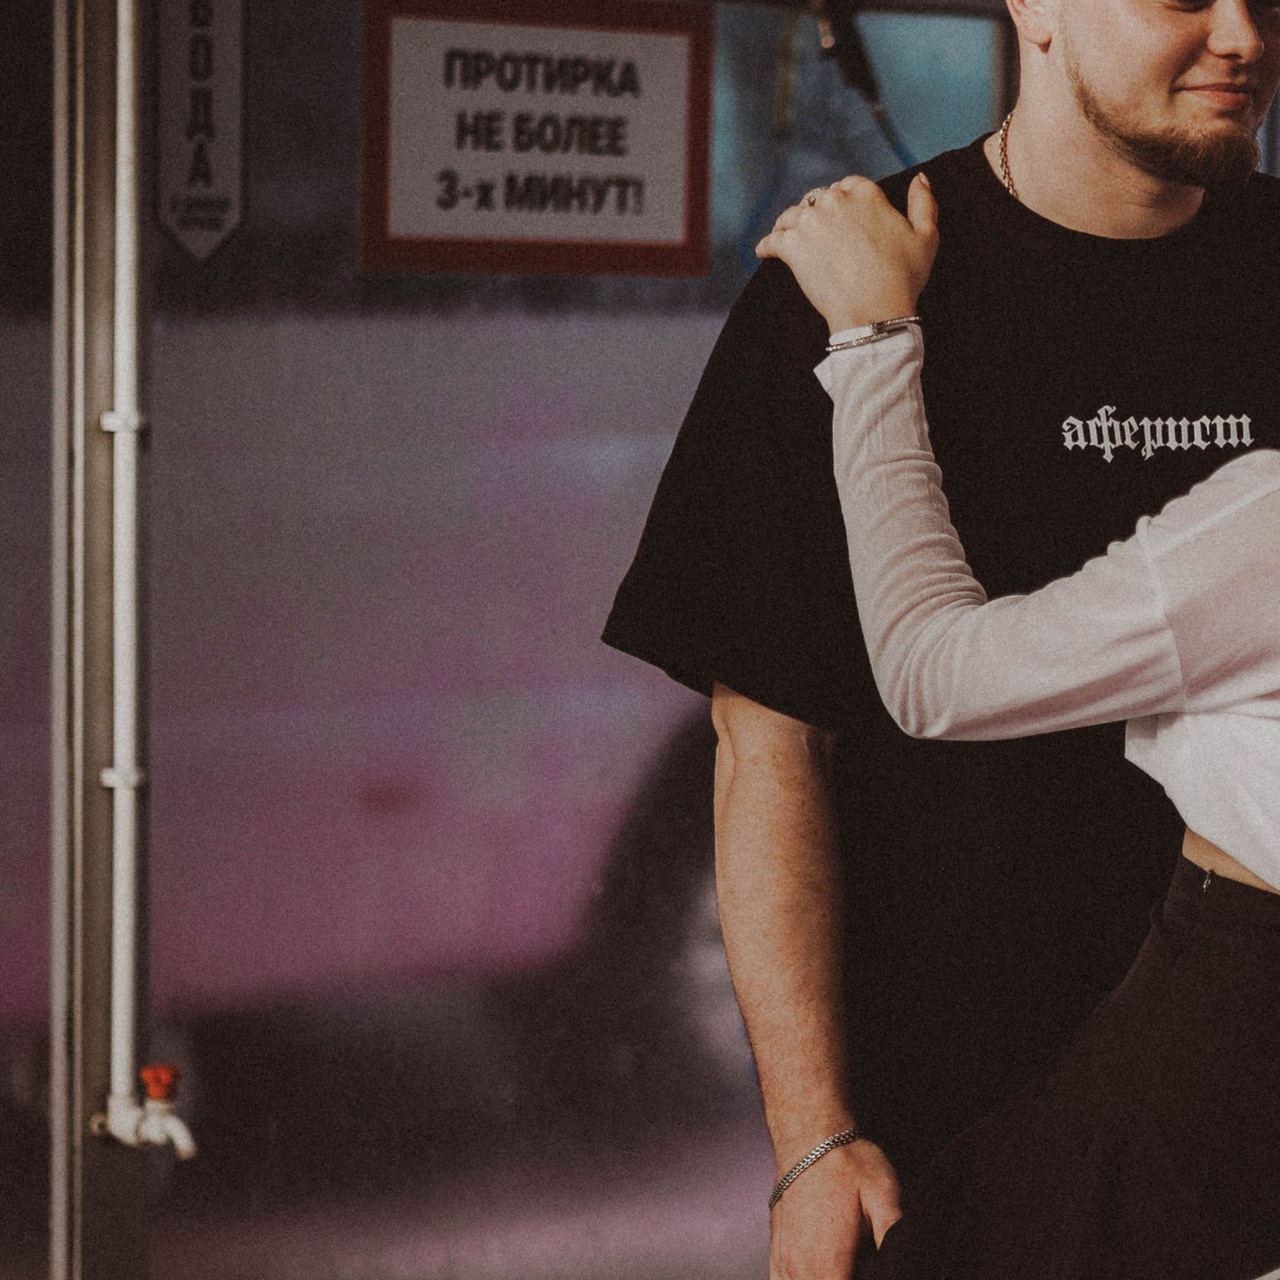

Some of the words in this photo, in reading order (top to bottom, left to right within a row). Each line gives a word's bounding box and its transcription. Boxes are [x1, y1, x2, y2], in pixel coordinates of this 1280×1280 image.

[443, 49, 641, 97] ПРОТИРКА
[455, 111, 504, 152] НЕ
[513, 113, 629, 157] БОЛЕЕ
[503, 173, 646, 217] МИНУТ!
[1061, 404, 1255, 463] аферист
